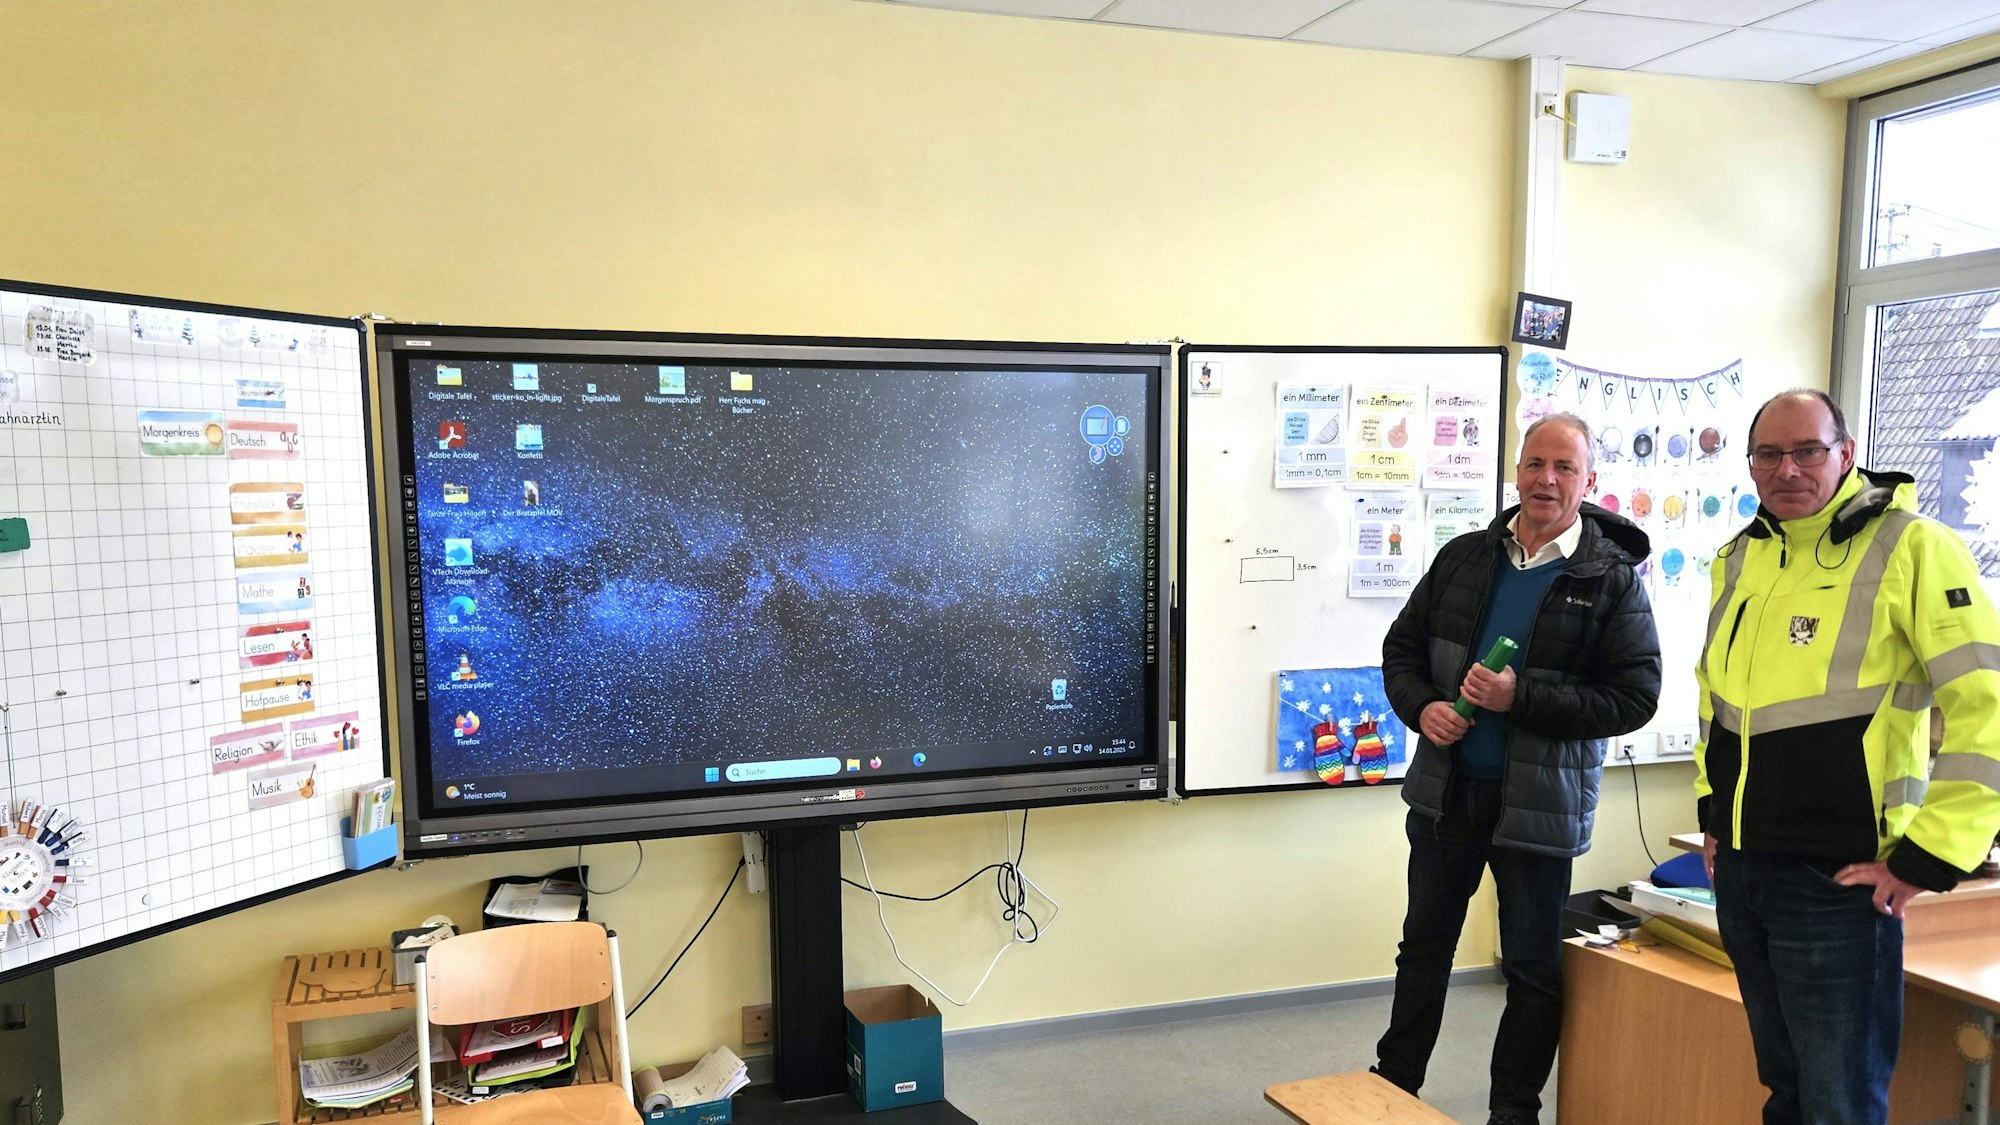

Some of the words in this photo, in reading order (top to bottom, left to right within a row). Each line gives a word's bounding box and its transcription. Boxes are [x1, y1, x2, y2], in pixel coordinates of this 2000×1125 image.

[428, 392, 455, 401] Digitale
[455, 392, 473, 400] Tafel
[645, 396, 702, 405] Morgenspruch.pdf
[1299, 394, 1340, 402] Millimeter
[1370, 397, 1413, 407] Zentimeter
[1449, 398, 1487, 407] Dezimeter
[0, 411, 61, 425] ahnärztin
[142, 425, 200, 443] Morgenkreis
[230, 432, 266, 446] Deutsch
[1306, 453, 1327, 461] mm
[1371, 454, 1376, 464] 1
[1378, 456, 1395, 464] cm
[1455, 454, 1471, 464] dm
[1285, 469, 1305, 477] 1mm
[1315, 468, 1342, 478] 0,1cm
[1356, 471, 1373, 479] 1cm
[1384, 471, 1410, 480] 10mm
[1462, 471, 1484, 479] 10cm
[1381, 506, 1403, 514] Meter
[1435, 506, 1447, 514] ein
[1448, 506, 1484, 514] Kilometer
[238, 539, 274, 555] Pause
[454, 568, 488, 576] Download
[1384, 564, 1394, 572] m
[1360, 579, 1372, 587] 1m
[1383, 578, 1411, 587] 100cm
[243, 584, 274, 599] Mathe
[472, 625, 488, 633] Edge
[244, 641, 275, 655] Lesen
[474, 681, 494, 690] player
[245, 692, 290, 711] Hofpause
[1046, 703, 1073, 711] Papierkorb
[295, 730, 318, 747] Ethik
[457, 738, 480, 746] Firefox
[214, 744, 253, 763] Religion
[745, 767, 766, 776] Suche
[252, 779, 281, 797] Musik
[464, 783, 475, 791] 1°C
[464, 792, 482, 800] Meist
[483, 790, 507, 799] sonnig
